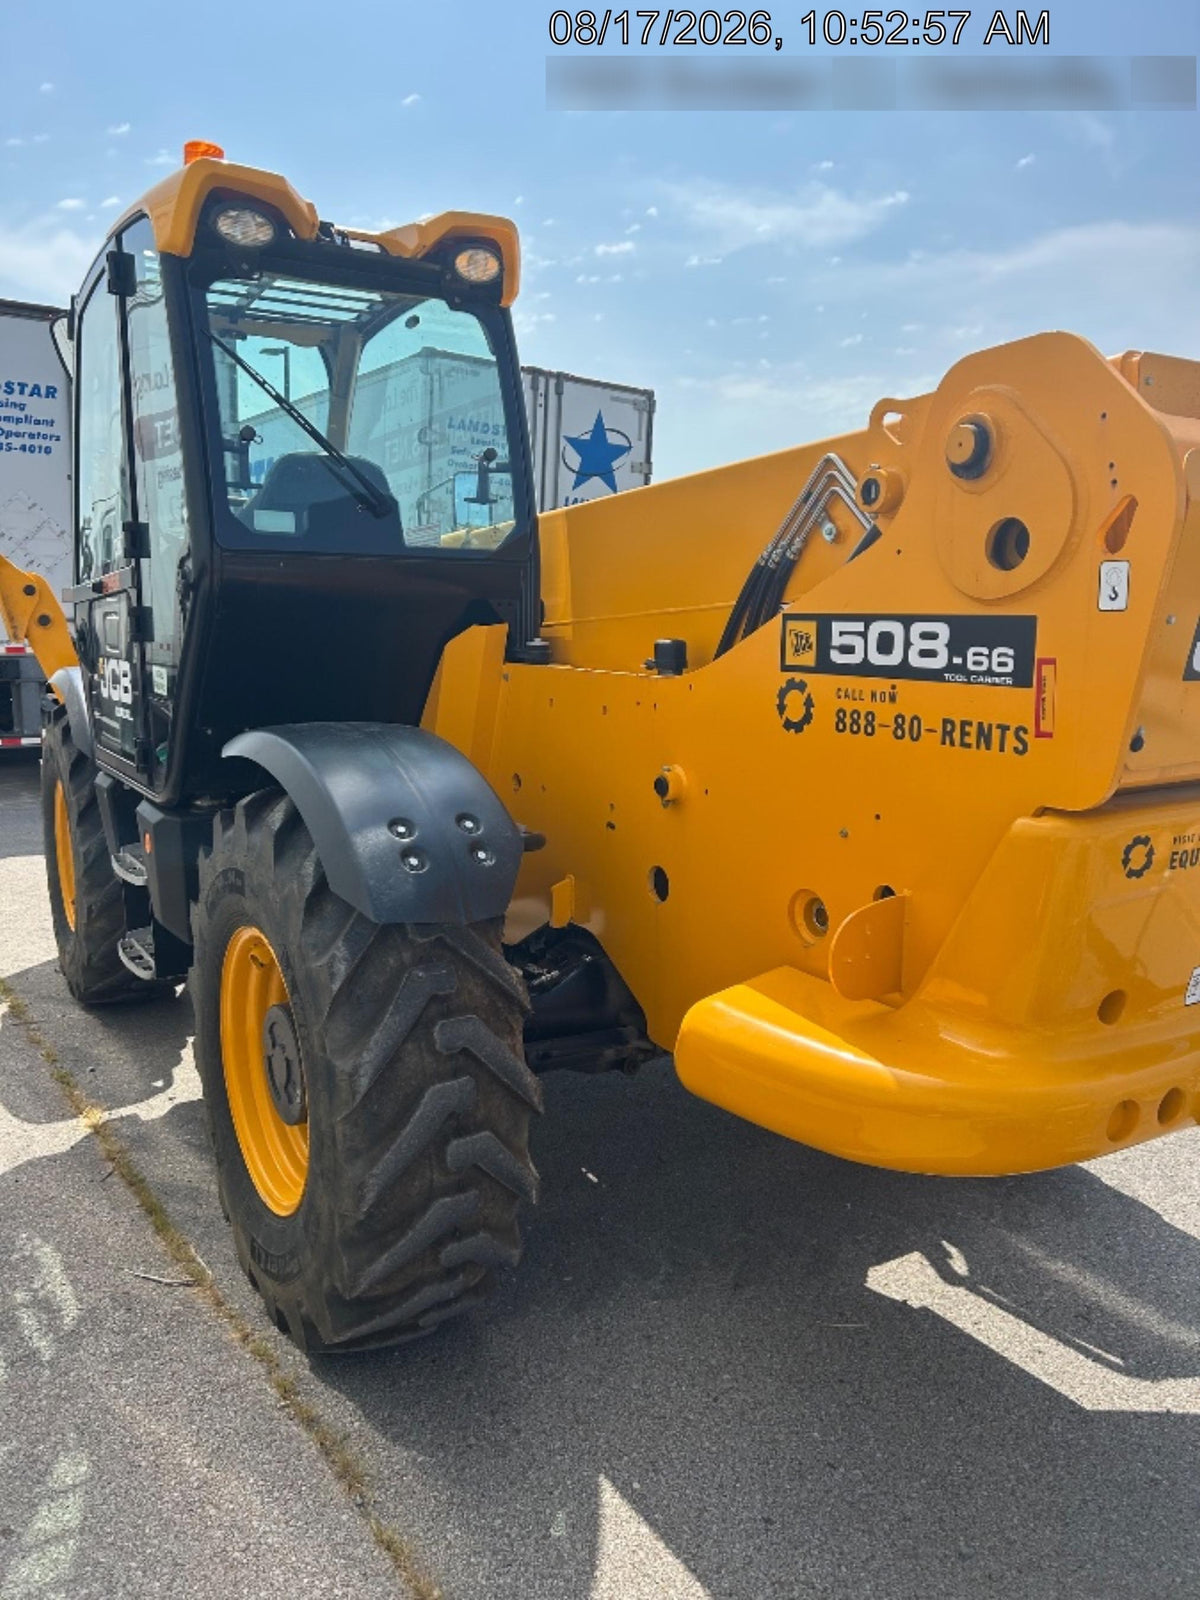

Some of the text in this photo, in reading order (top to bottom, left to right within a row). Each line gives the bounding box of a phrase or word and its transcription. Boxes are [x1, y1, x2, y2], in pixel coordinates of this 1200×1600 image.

[0, 380, 58, 399] STAR
[100, 657, 132, 704] JCB
[943, 673, 968, 682] TOOL
[836, 687, 898, 704] CALL NOW
[834, 708, 1029, 756] 888-80-RENTS
